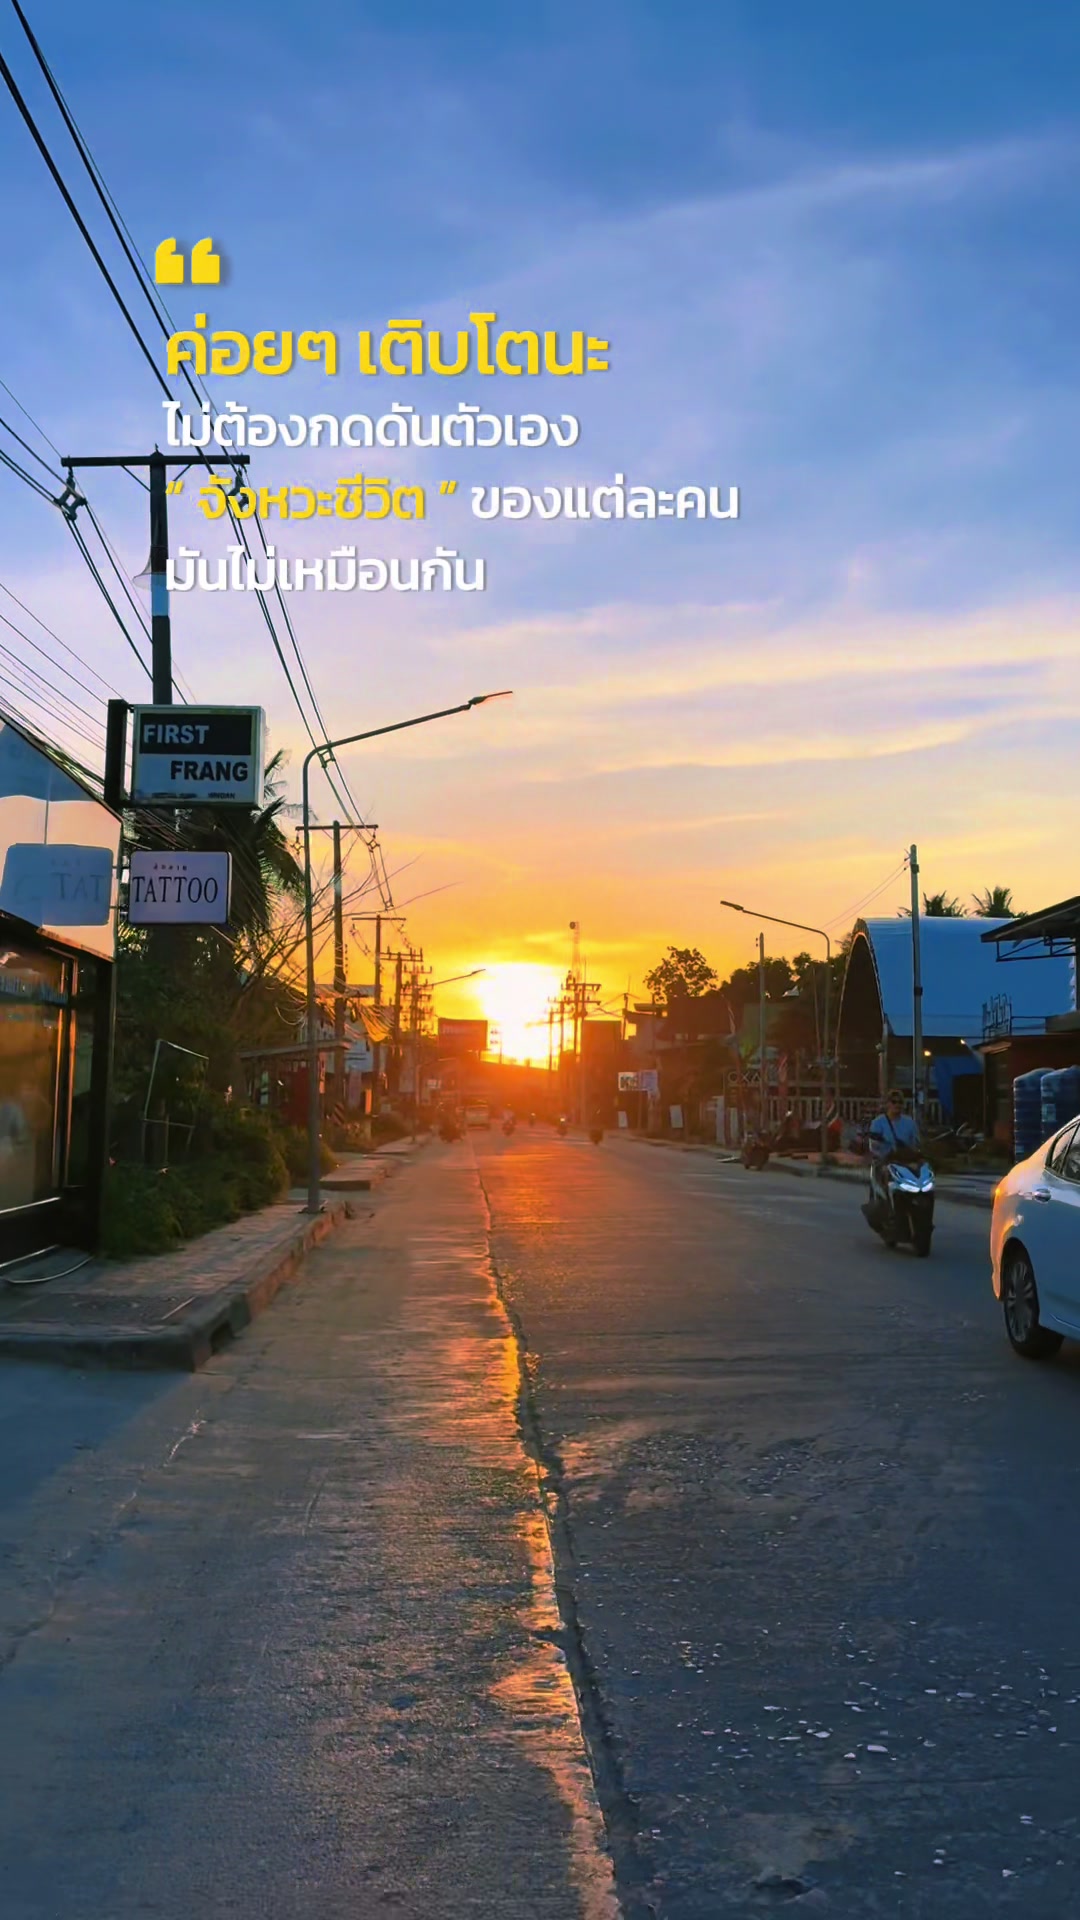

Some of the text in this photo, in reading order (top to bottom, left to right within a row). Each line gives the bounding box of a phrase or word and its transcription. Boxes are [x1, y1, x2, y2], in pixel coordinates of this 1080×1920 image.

[143, 724, 209, 744] FIRST
[170, 760, 248, 782] FRANG
[132, 876, 219, 904] TATTOO
